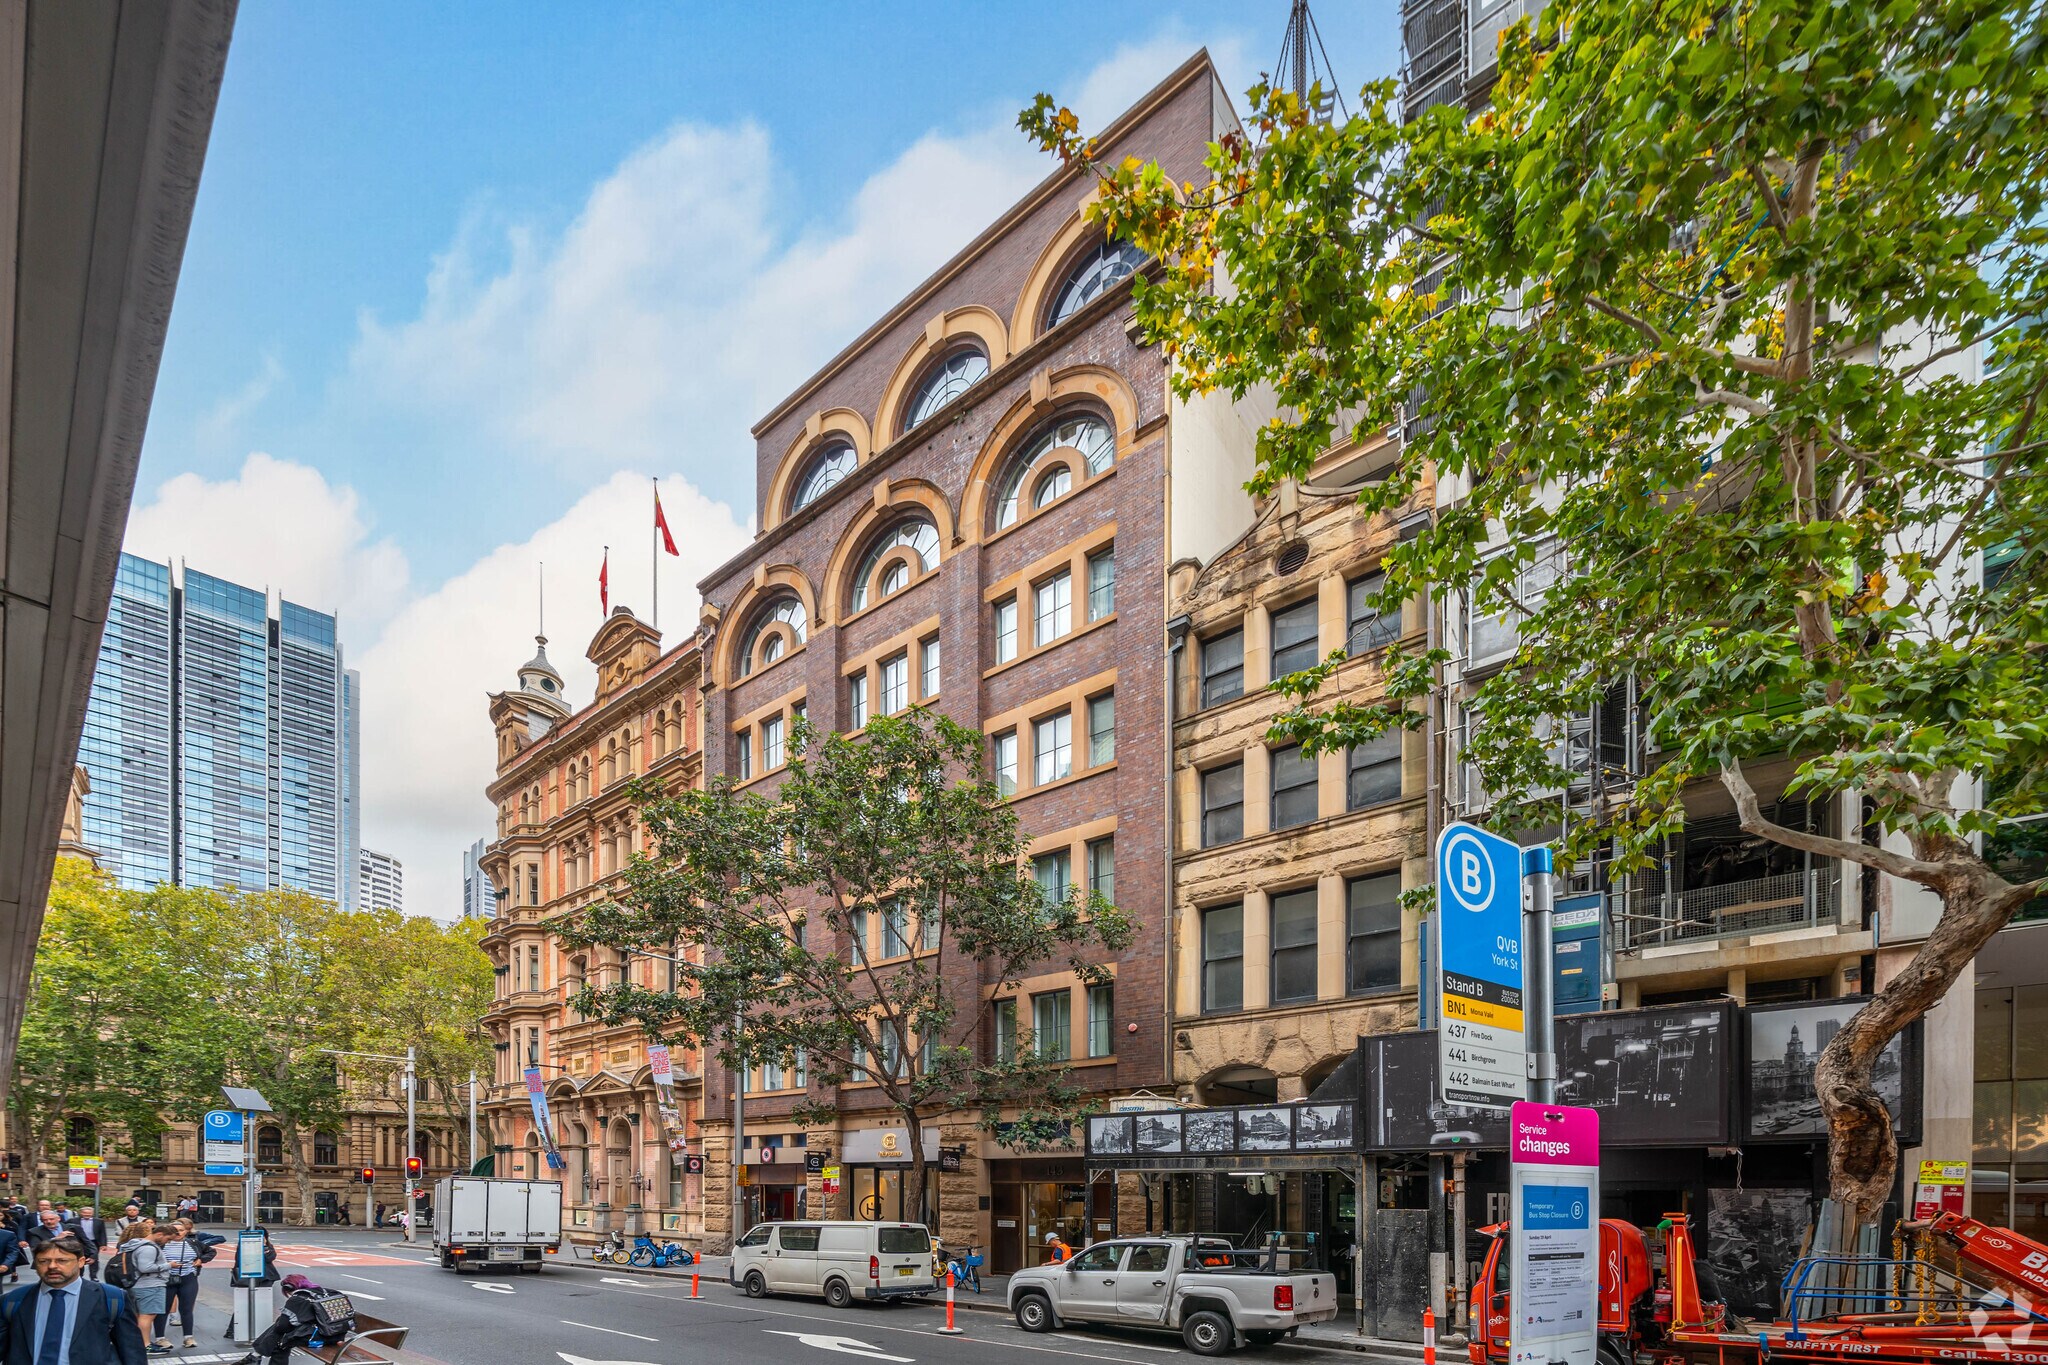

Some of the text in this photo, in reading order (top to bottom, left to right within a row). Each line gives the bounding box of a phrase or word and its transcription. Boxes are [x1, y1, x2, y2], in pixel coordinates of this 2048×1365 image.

[1461, 850, 1482, 895] B
[1496, 935, 1518, 954] QVB
[1491, 953, 1518, 971] York St
[1446, 975, 1484, 997] Stand B
[1447, 1000, 1494, 1019] BN1 Mona Vale
[1448, 1024, 1493, 1041] 437 Five Dock
[1448, 1047, 1497, 1065] 441 Birchgrove
[1449, 1071, 1515, 1089] 442 Balmain East Wharf
[215, 1116, 224, 1124] B
[1520, 1123, 1547, 1135] Service
[1520, 1135, 1570, 1157] changes
[1529, 1203, 1554, 1211] Temporary
[1575, 1205, 1580, 1216] B
[1841, 1343, 1881, 1354] FIRST
[2000, 1352, 2048, 1363] 1300
